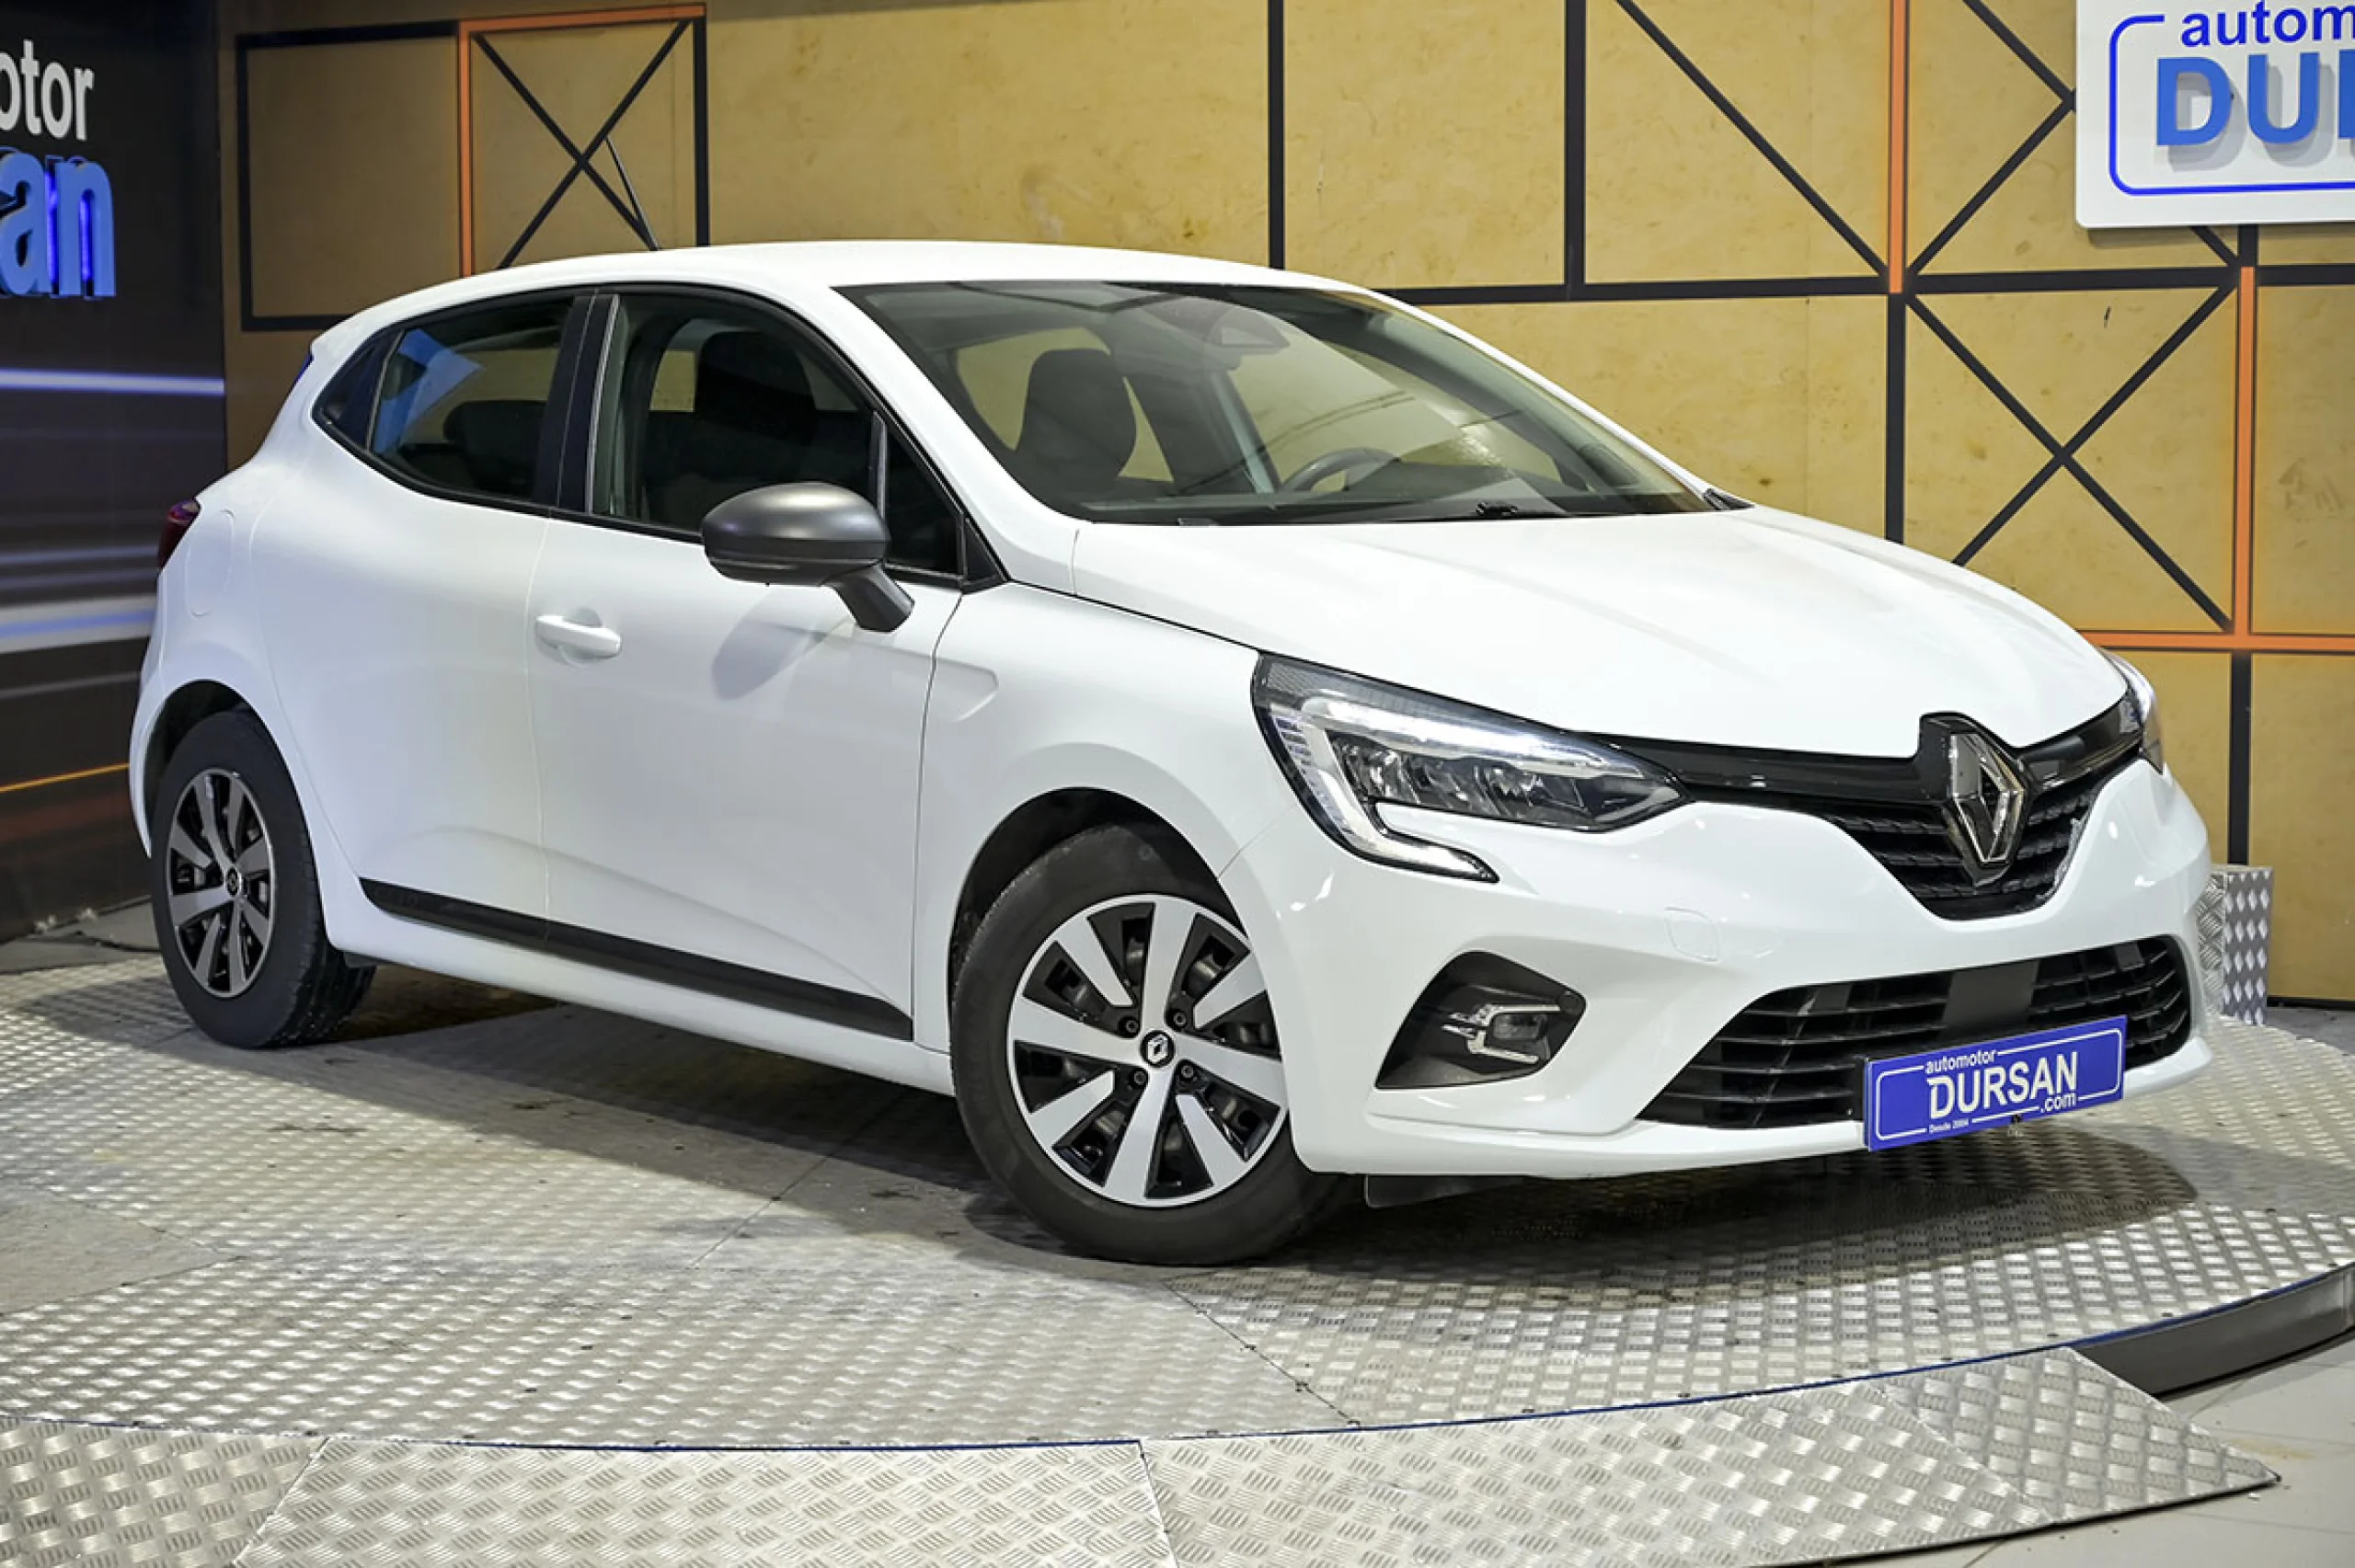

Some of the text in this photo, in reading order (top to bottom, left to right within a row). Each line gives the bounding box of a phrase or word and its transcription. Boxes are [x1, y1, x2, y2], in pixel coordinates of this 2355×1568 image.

[2156, 49, 2355, 146] DU
[1925, 1049, 1996, 1074] automotor
[1926, 1051, 2078, 1119] DURSAN
[2040, 1093, 2076, 1113] .com
